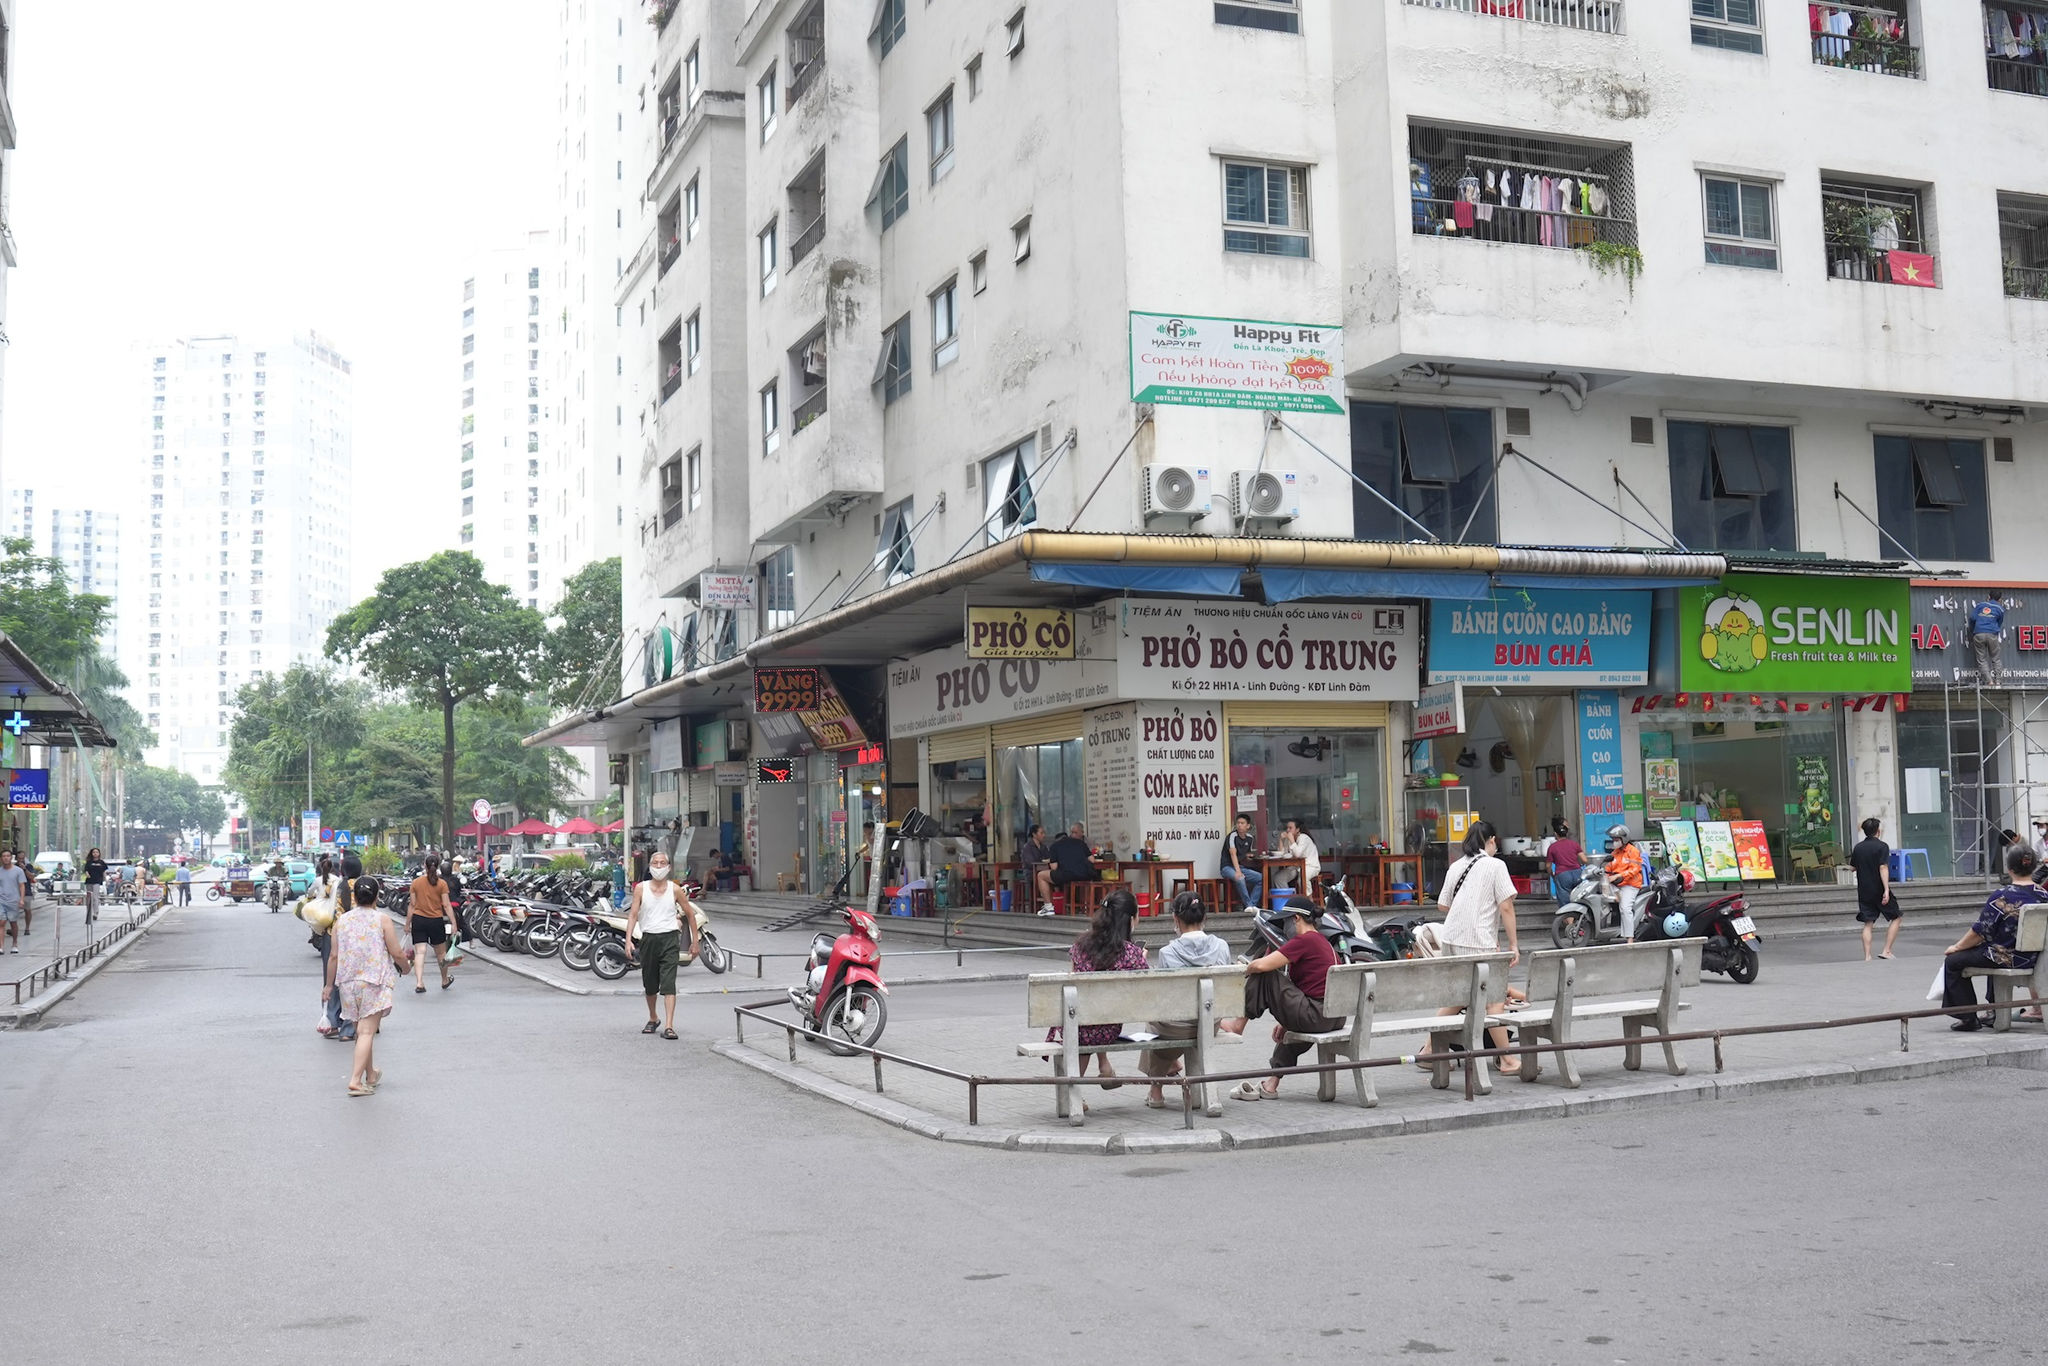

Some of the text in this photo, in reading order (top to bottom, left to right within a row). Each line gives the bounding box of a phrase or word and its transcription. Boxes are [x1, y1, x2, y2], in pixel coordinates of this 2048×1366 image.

[1152, 339, 1185, 348] HAPPY
[1234, 325, 1320, 344] Happy Fit
[1141, 353, 1176, 365] Cam
[1181, 355, 1204, 368] kết
[1209, 357, 1244, 369] Hoàn
[1293, 365, 1327, 375] 100%
[1158, 370, 1186, 382] Nếu
[1191, 373, 1237, 387] không
[1242, 376, 1264, 388] đạt
[1270, 377, 1292, 390] kết
[1132, 605, 1363, 621] TIỆM ĂN THƯƠNG HIỆU CHUẨN GỐC LÀNG VÂN CÙ
[1452, 605, 1498, 634] BÁNH
[1552, 612, 1585, 635] CAO
[1588, 601, 1632, 635] BẰNG
[972, 611, 1028, 648] PHỞ
[1771, 606, 1898, 646] SENLIN
[984, 646, 1059, 657] Gia truyền
[1141, 623, 1397, 671] PHỞ BÒ CỒ TRUNG
[1494, 638, 1593, 667] BÚN CHẢ
[1771, 651, 1897, 662] Fresh fruit tea & Milk tea
[760, 671, 814, 691] VÀNG
[892, 667, 921, 687] TIỆM ĂN
[1172, 681, 1182, 690] Ki
[1198, 681, 1210, 690] 22
[1213, 681, 1240, 690] HH1A
[1248, 682, 1267, 691] Linh
[1269, 681, 1300, 694] Đường
[1308, 682, 1326, 692] KĐT
[1328, 682, 1346, 692] Linh
[1349, 682, 1371, 692] Đàm
[760, 691, 815, 711] 9999
[1586, 702, 1611, 717] BÁNH
[1143, 707, 1217, 742] PHỞ BÒ
[1418, 707, 1450, 728] BÚN CHẢ
[1101, 727, 1131, 744] TRUNG
[1587, 723, 1613, 740] CUỐN
[1147, 747, 1214, 761] CHẤT LƯỢNG CAO
[1592, 751, 1611, 764] CAO
[1144, 769, 1219, 798] CƠM RANG
[1590, 768, 1616, 787] BẰNG
[13, 792, 46, 803] CHÂU
[1584, 792, 1603, 815] BÚN
[1605, 789, 1624, 815] CHẢ
[1152, 803, 1213, 817] NGON ĐẶC BIỆT
[1165, 828, 1182, 840] XÀO
[1204, 828, 1220, 840] XÀO
